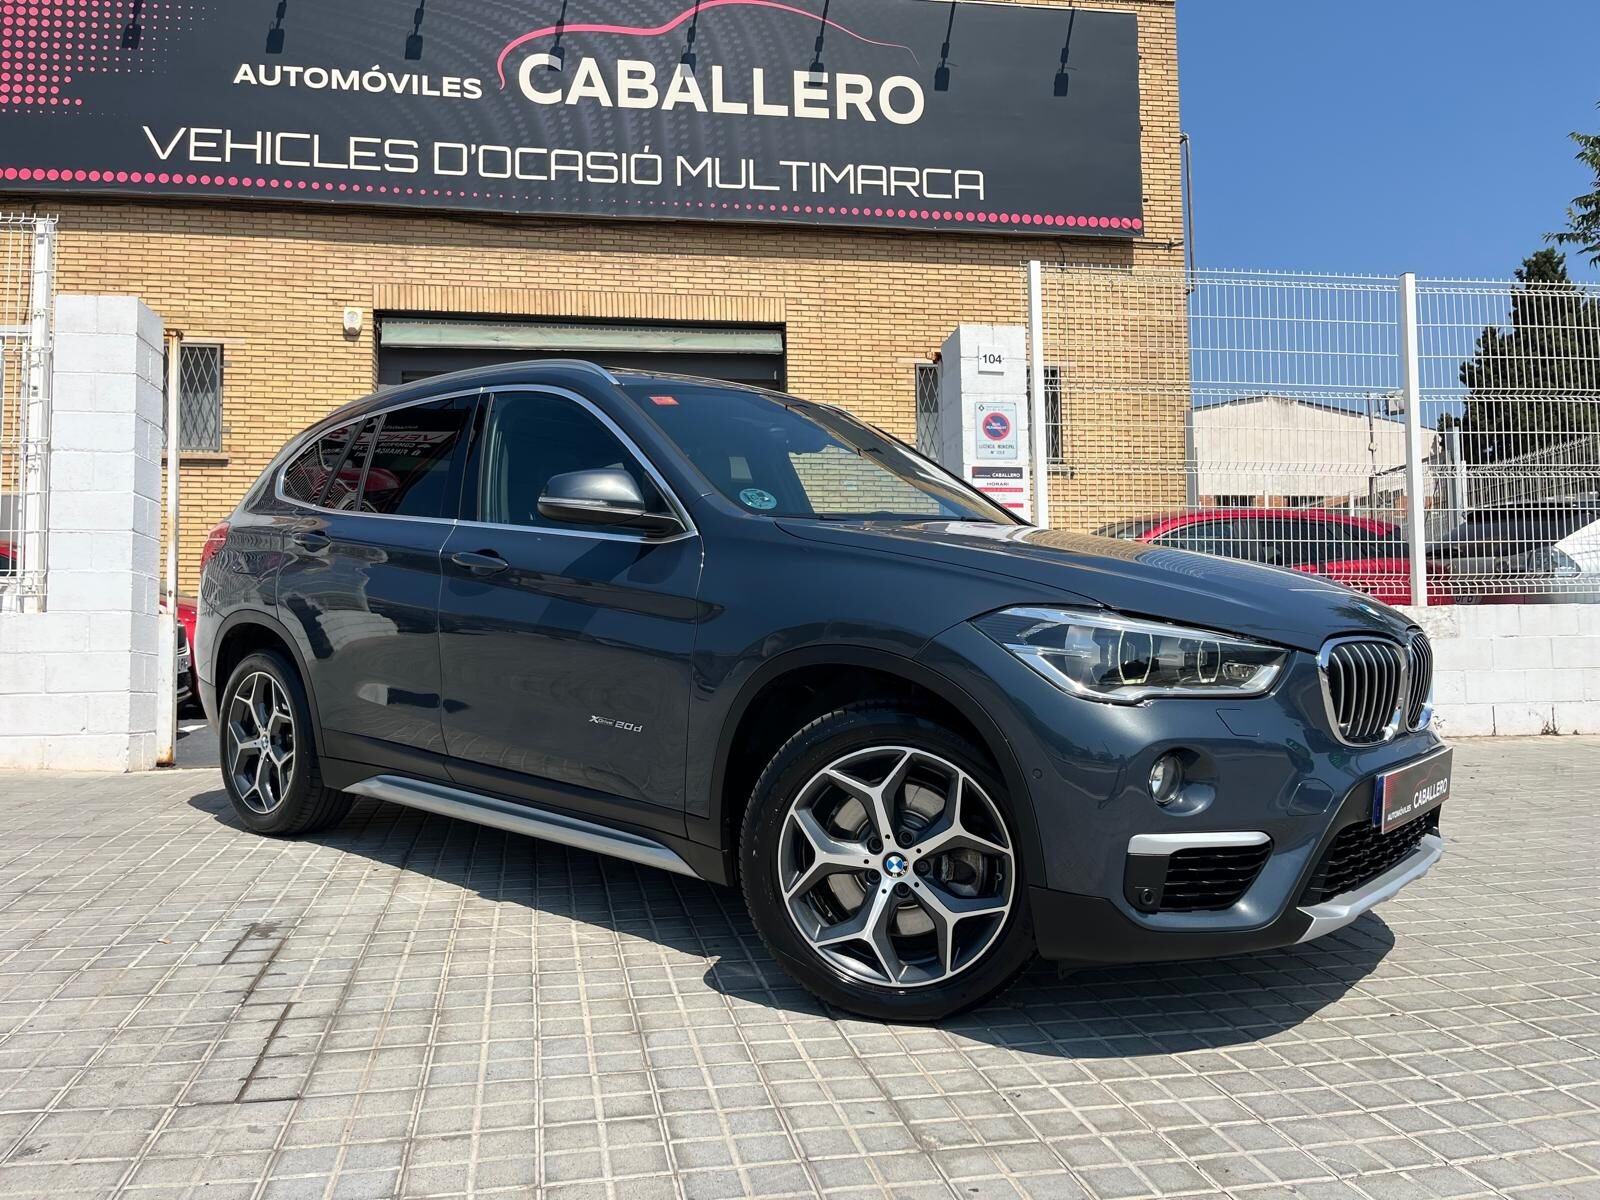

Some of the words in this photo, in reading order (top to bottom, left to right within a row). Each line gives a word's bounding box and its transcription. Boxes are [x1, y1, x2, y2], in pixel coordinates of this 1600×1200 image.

[233, 64, 483, 100] AUTOMÓVILES
[518, 53, 925, 125] CABALLERO
[142, 125, 419, 174] VEHICLES
[433, 141, 663, 185] D'OCASIÓ
[676, 155, 985, 201] MULTIMARCA
[614, 720, 643, 733] 20d
[1413, 777, 1448, 809] CABALLERO
